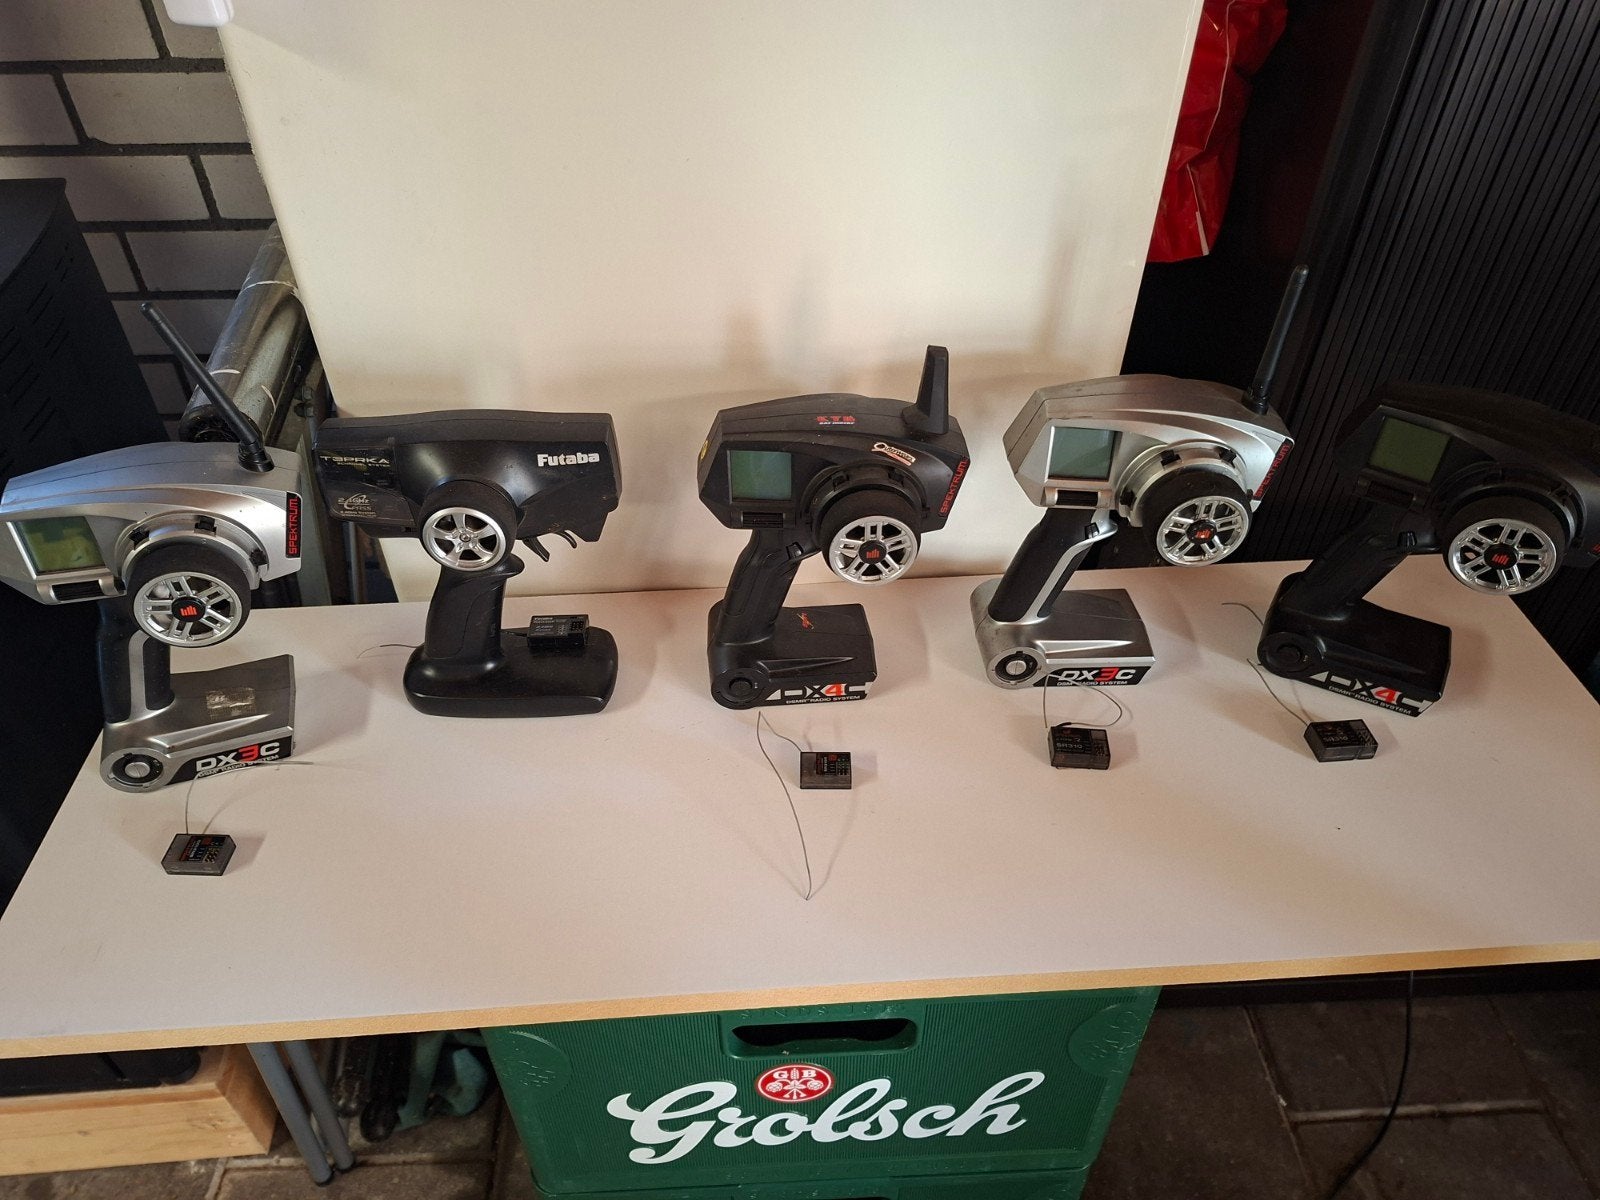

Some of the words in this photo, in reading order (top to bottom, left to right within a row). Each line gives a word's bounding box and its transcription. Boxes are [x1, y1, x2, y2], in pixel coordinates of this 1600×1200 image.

[537, 452, 600, 467] Futaba
[940, 459, 968, 514] SPEKTRUM
[288, 496, 298, 555] SPEKTRUM
[1058, 668, 1137, 682] DX3C
[196, 742, 280, 773] DX3C
[773, 1070, 789, 1079] G
[801, 1069, 817, 1078] B
[606, 1071, 1045, 1164] Grolsch
